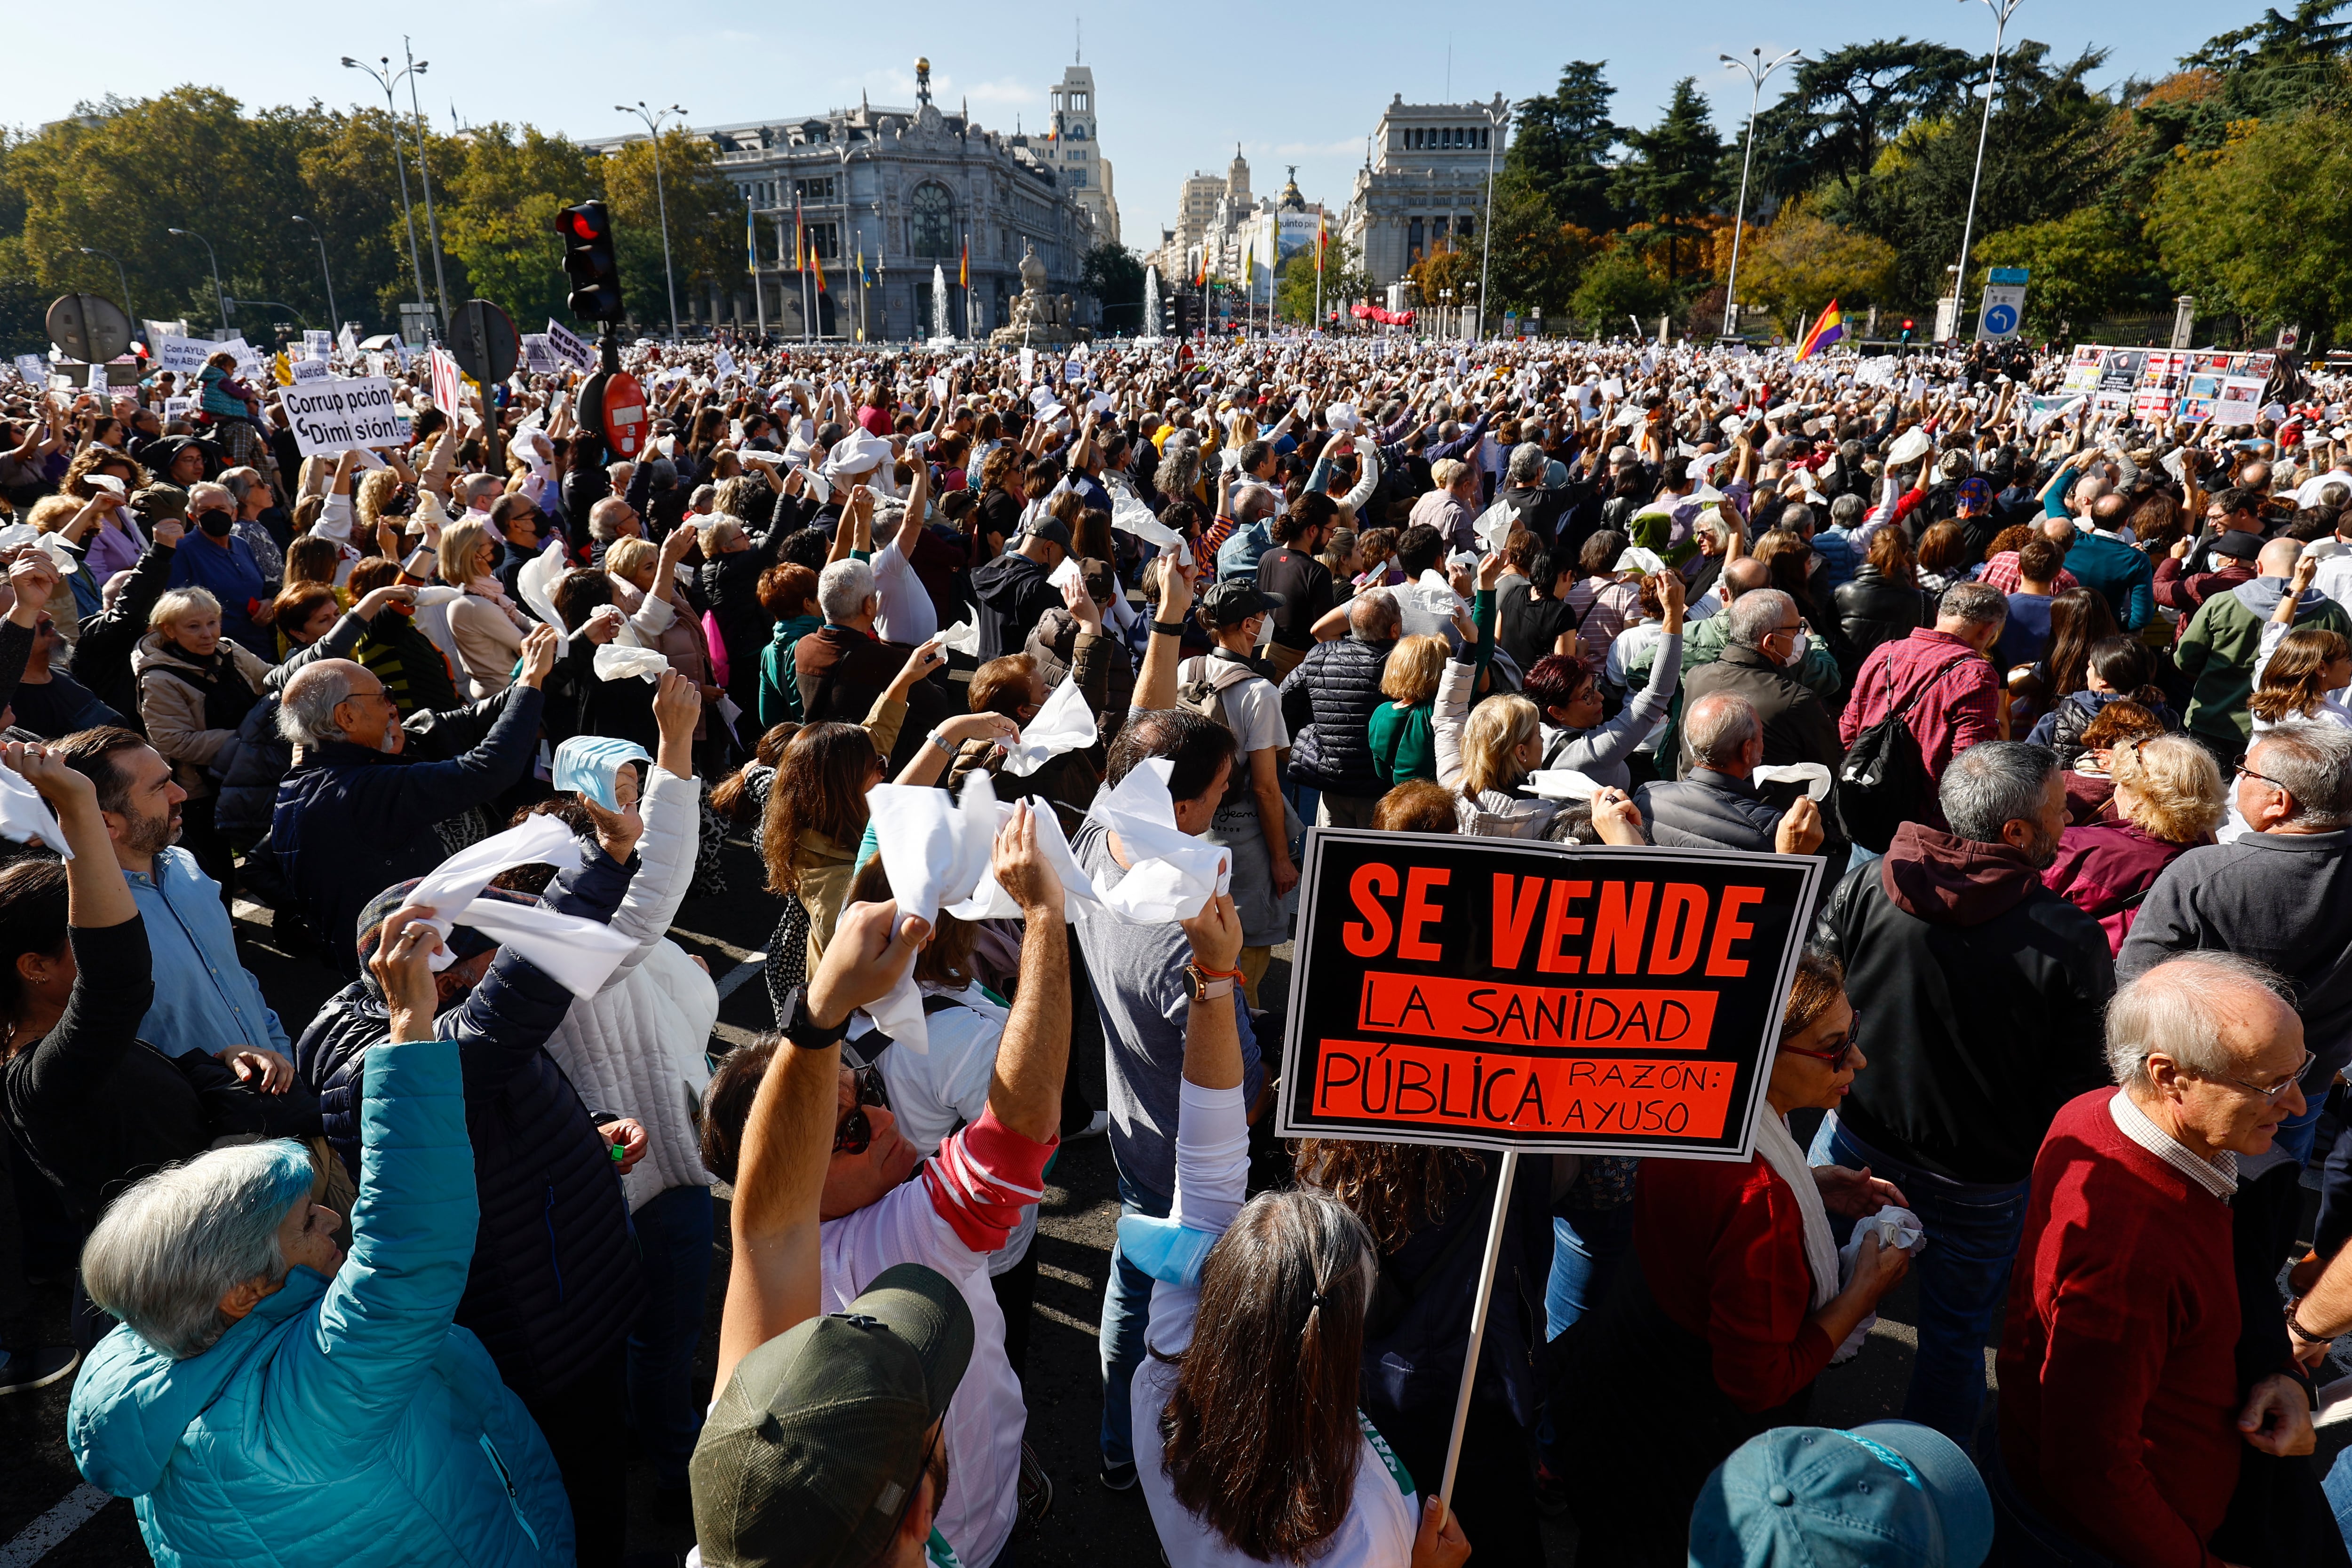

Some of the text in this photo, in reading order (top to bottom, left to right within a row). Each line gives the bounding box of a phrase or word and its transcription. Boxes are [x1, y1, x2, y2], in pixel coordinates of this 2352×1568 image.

[1278, 219, 1303, 230] quinto
[1304, 220, 1318, 230] pino.
[165, 344, 208, 356] Con AYUS
[1164, 338, 1175, 347] NO
[164, 356, 203, 366] hay ABUS
[431, 350, 456, 418] NO
[286, 385, 391, 415] Corrup pción
[308, 416, 400, 445] Dimi sión!
[1342, 863, 1765, 977] SE VENDE
[1365, 980, 1691, 1042] LA SANIDAD
[1569, 1061, 1721, 1091] RAZÓN:
[1562, 1099, 1689, 1134] AYUSO
